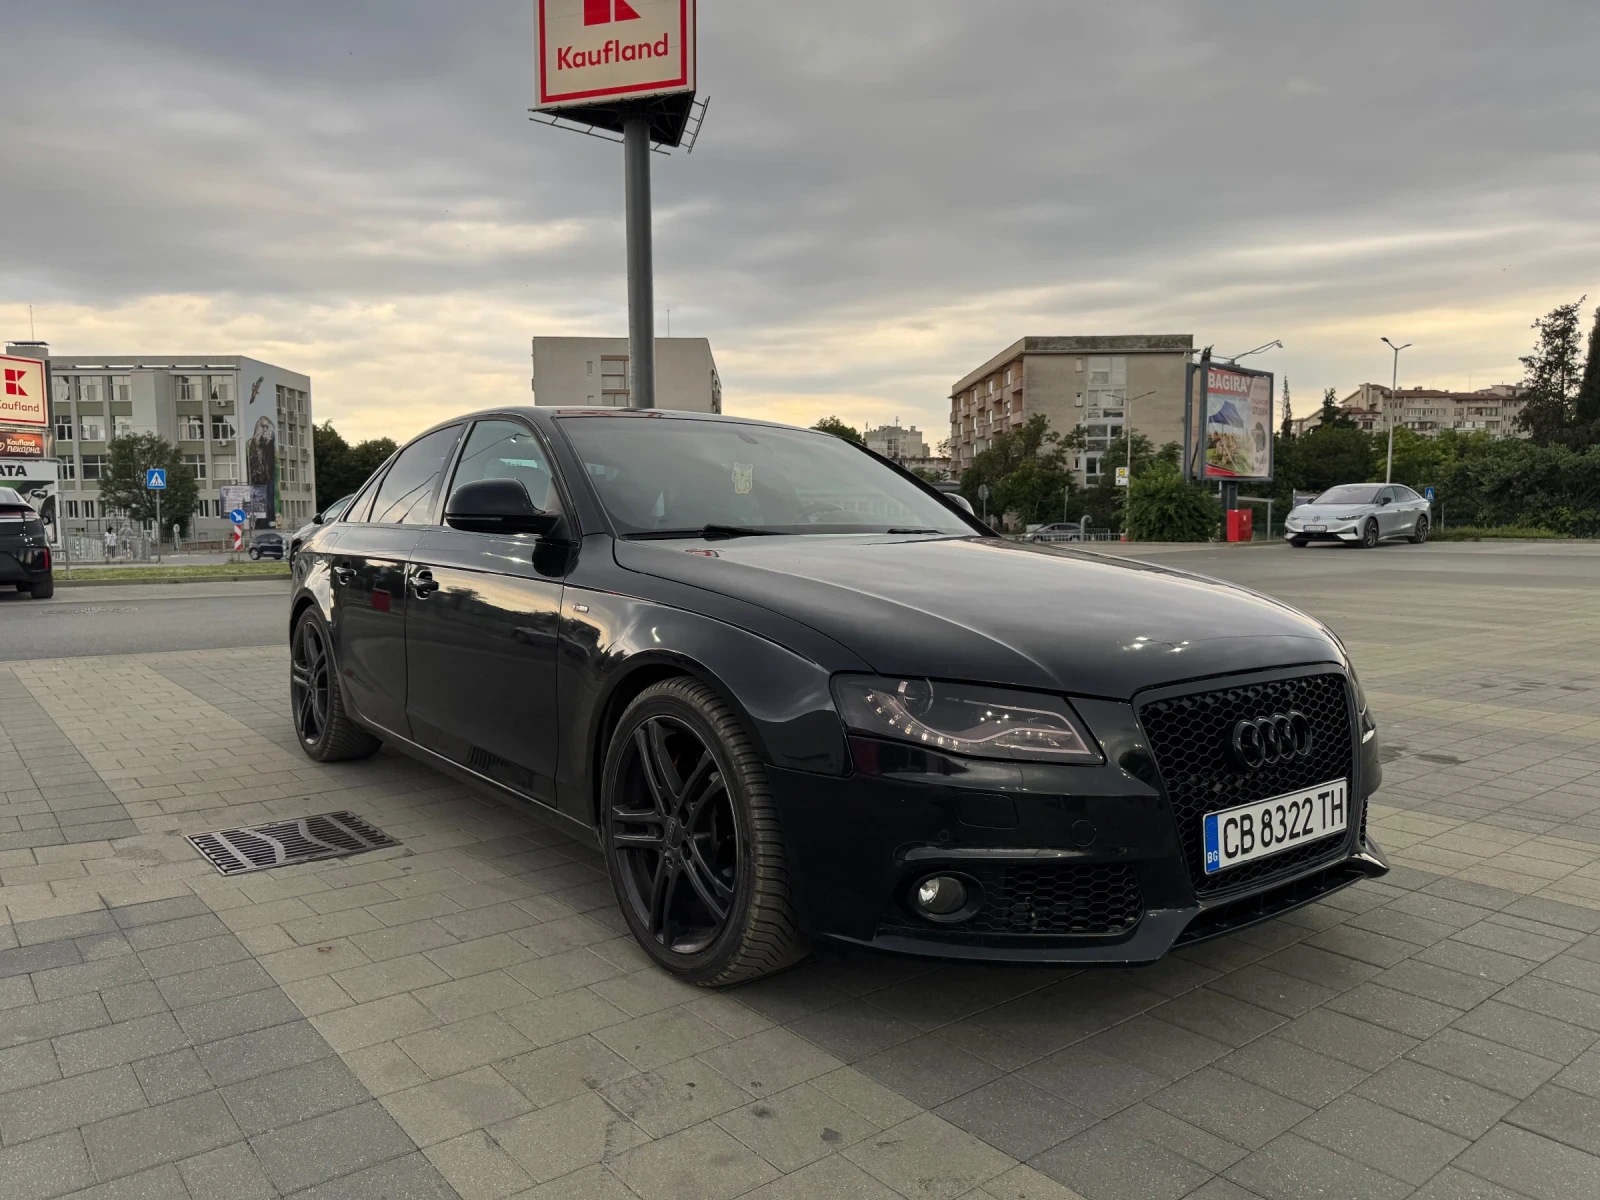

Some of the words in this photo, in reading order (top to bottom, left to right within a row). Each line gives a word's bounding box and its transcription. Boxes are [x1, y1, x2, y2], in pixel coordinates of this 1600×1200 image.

[557, 32, 669, 71] Kaufland
[0, 400, 40, 413] aufland
[7, 438, 35, 447] Kaufland
[7, 445, 41, 454] пекарна
[1223, 813, 1255, 859] CB
[1260, 797, 1314, 848] 8322
[1317, 787, 1344, 830] TH
[1207, 850, 1219, 864] BG
